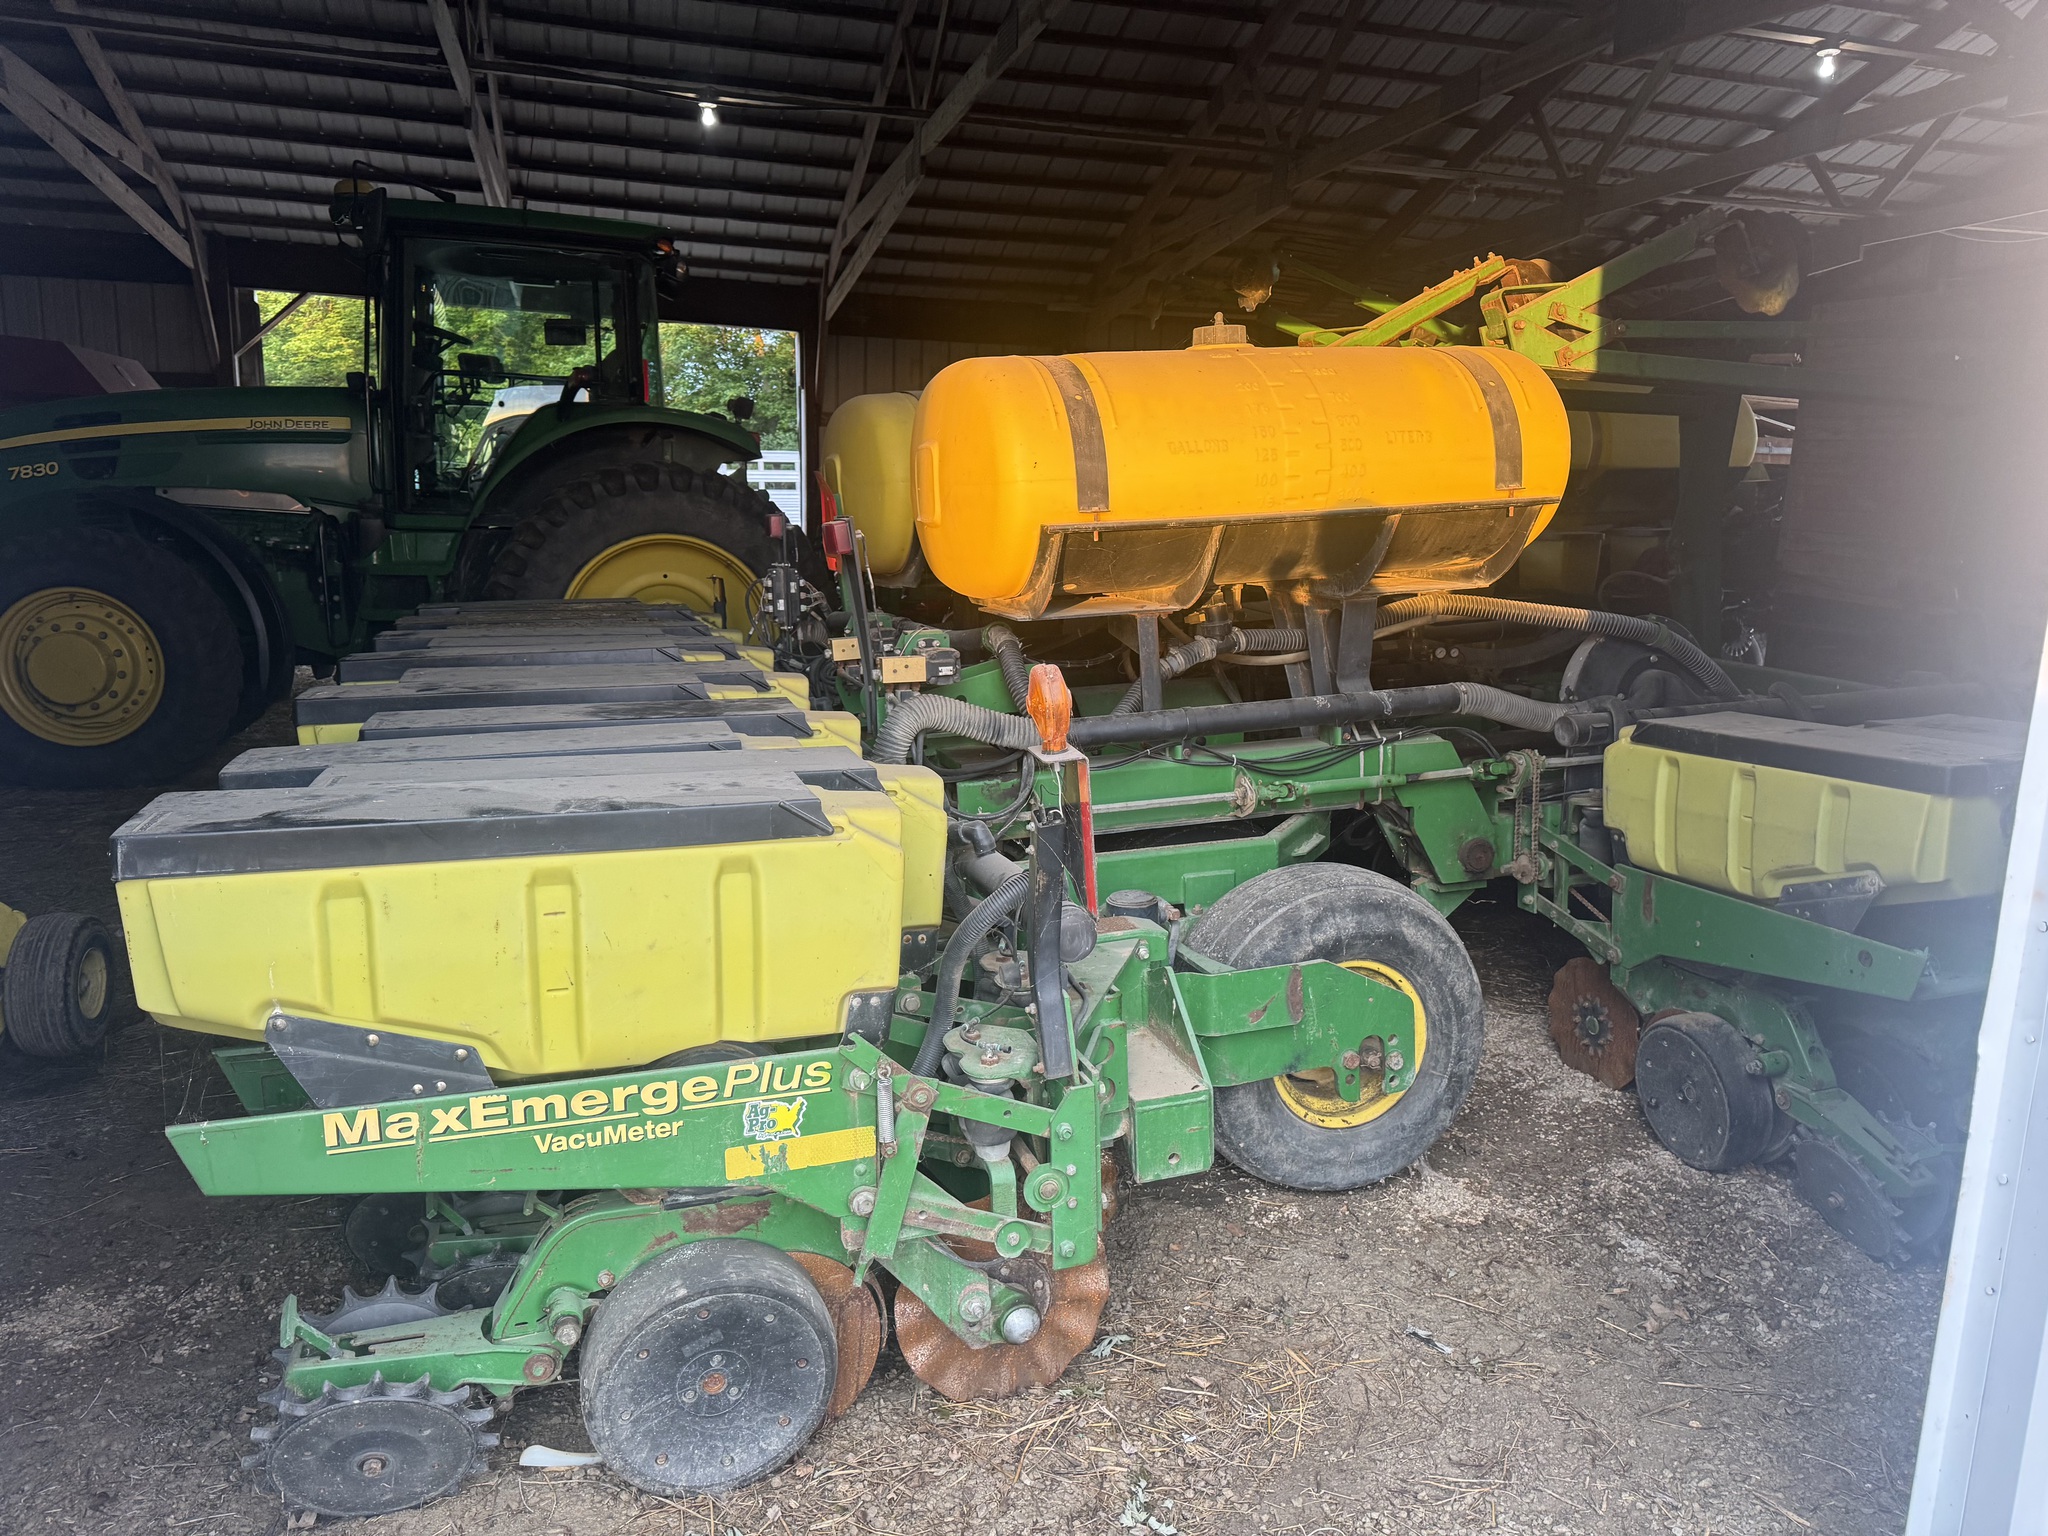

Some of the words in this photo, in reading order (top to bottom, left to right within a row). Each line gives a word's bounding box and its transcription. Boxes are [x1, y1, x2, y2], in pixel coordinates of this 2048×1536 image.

[246, 419, 282, 429] JOHN
[285, 419, 329, 429] DEERE
[8, 461, 59, 480] 7830
[748, 1118, 777, 1132] Pro
[533, 1120, 684, 1154] VacuMeter
